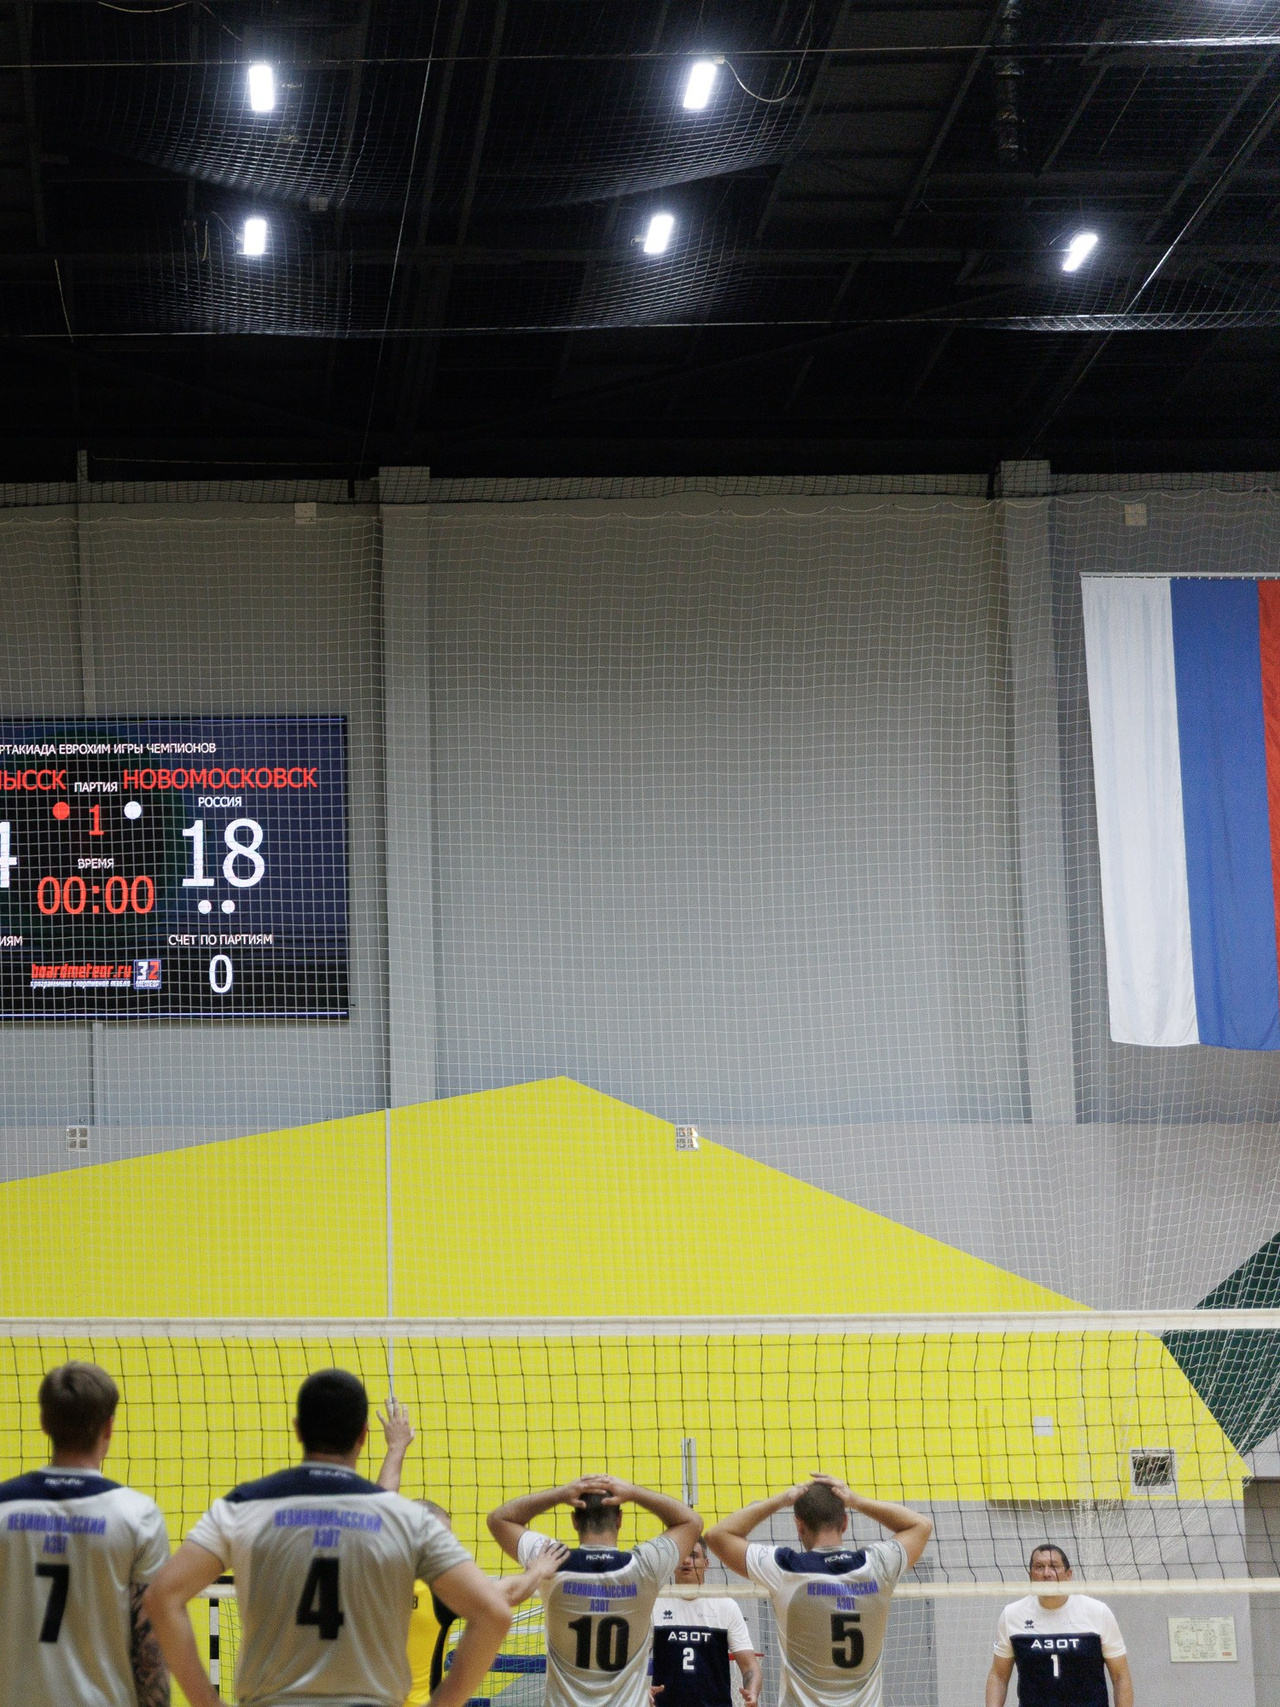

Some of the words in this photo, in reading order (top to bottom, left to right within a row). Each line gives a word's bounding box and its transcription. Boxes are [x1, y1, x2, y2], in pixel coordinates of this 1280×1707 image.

[59, 744, 111, 754] ЕВРОХИМ
[113, 743, 143, 754] ИГРЫ
[146, 742, 217, 754] ЧЕМПИОНОВ
[74, 782, 118, 792] ПАРТИЯ
[123, 767, 318, 789] НОВОМОСКОВСК
[198, 796, 242, 807] РОССИЯ
[88, 804, 104, 835] 1
[77, 858, 115, 869] ВРЕМЯ
[182, 818, 265, 888] 18
[37, 875, 154, 915] 00:00
[168, 934, 197, 945] СЧЕТ
[200, 934, 217, 945] ПО
[220, 934, 273, 945] ПАРТИЯМ
[31, 963, 132, 979] boardmeteor.ru
[209, 954, 233, 993] 0
[35, 1563, 70, 1643] 7
[296, 1557, 344, 1640] 4
[589, 1598, 610, 1612] АЗОТ
[836, 1596, 856, 1610] АЗОТ
[568, 1615, 629, 1671] 10
[668, 1631, 711, 1642] АЗОТ
[831, 1614, 865, 1669] 5
[1031, 1638, 1079, 1649] АЗОТ
[683, 1647, 695, 1670] 2
[1050, 1654, 1059, 1677] 1
